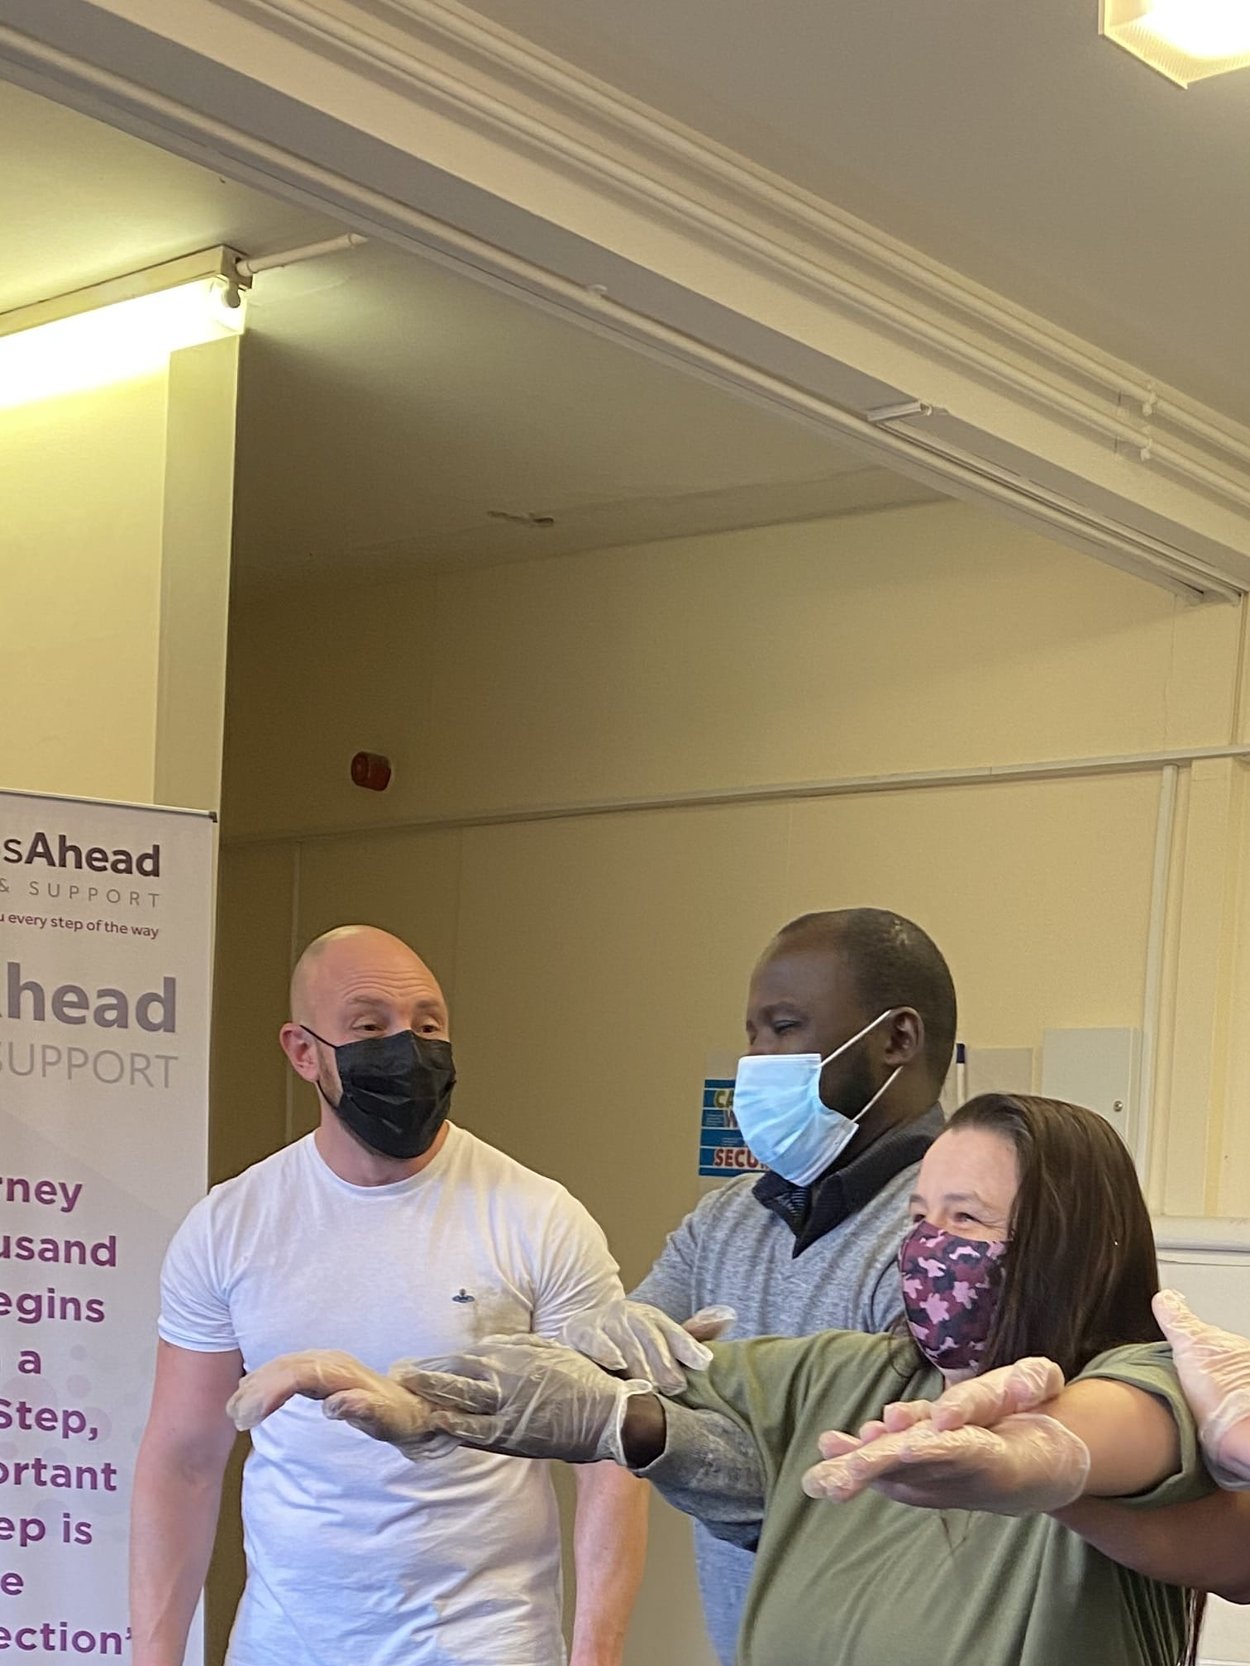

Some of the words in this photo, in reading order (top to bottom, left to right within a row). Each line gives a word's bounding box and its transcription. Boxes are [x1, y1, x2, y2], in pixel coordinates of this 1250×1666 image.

[3, 831, 160, 878] sAhead
[28, 880, 160, 908] SUPPORT
[7, 913, 47, 930] every
[50, 917, 83, 932] step
[86, 919, 104, 931] of
[104, 921, 128, 935] the
[131, 925, 159, 940] way
[0, 962, 177, 1034] head
[0, 1040, 179, 1089] UPPORT
[18, 1350, 42, 1375] a
[62, 1512, 93, 1545] is
[1, 1572, 24, 1596] e
